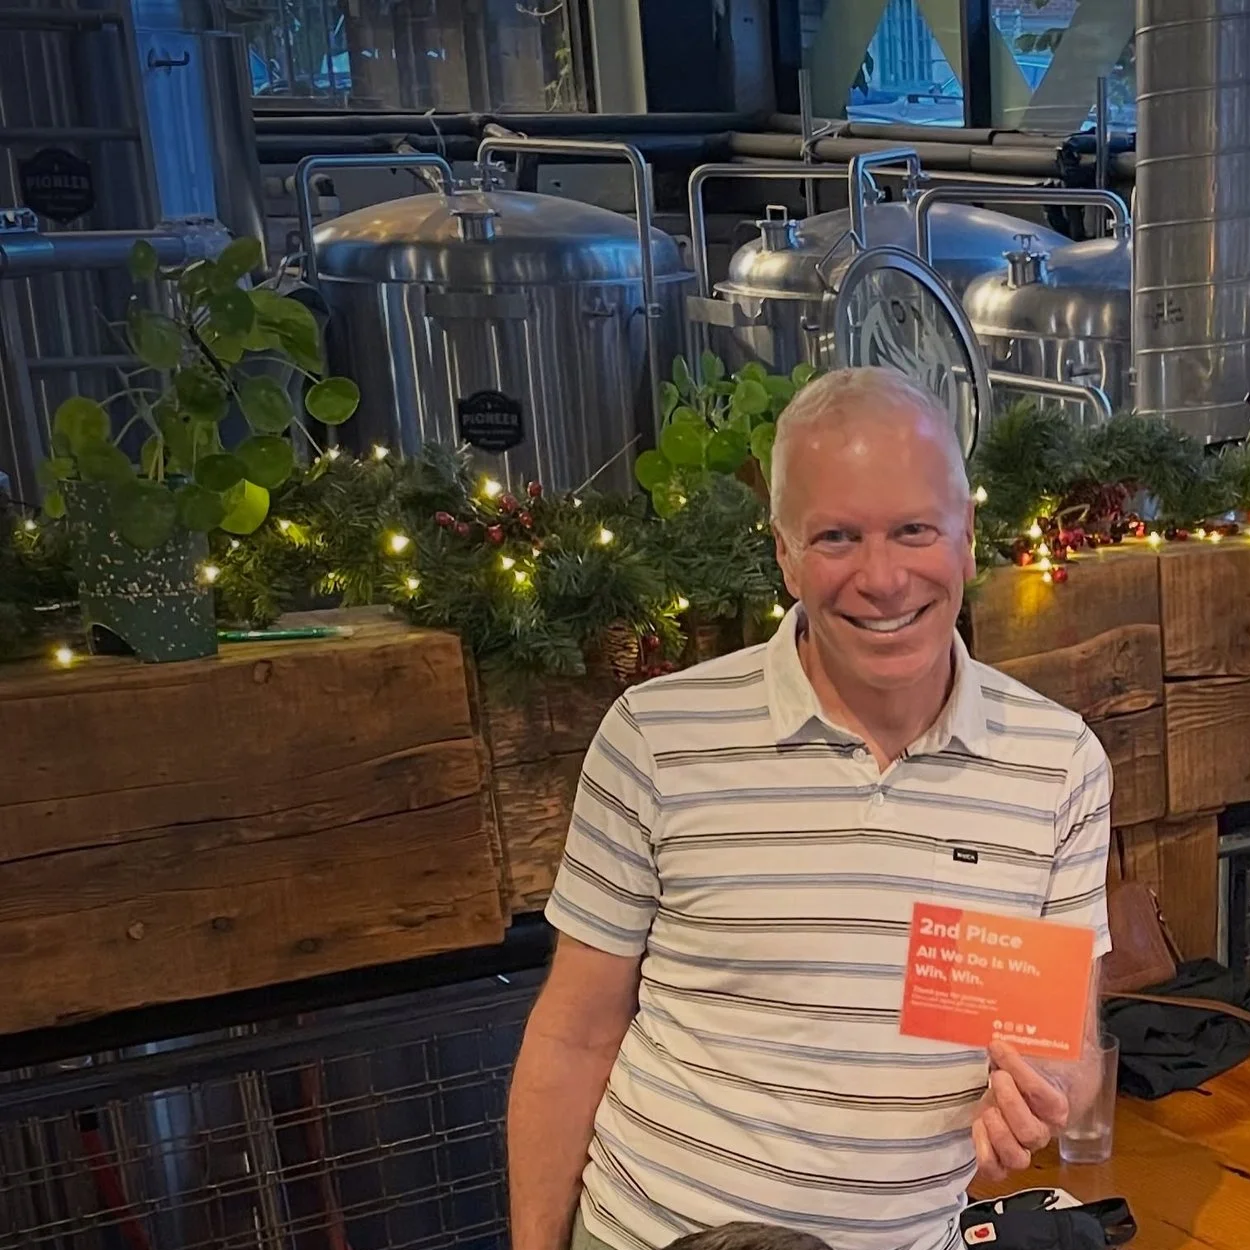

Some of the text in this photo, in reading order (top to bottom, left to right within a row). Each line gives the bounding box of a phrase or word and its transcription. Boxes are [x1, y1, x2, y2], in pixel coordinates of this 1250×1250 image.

[920, 917, 1023, 949] 2nd Place
[916, 945, 937, 959] All
[940, 947, 964, 963] We
[967, 953, 989, 968] Do
[991, 956, 1004, 969] Is
